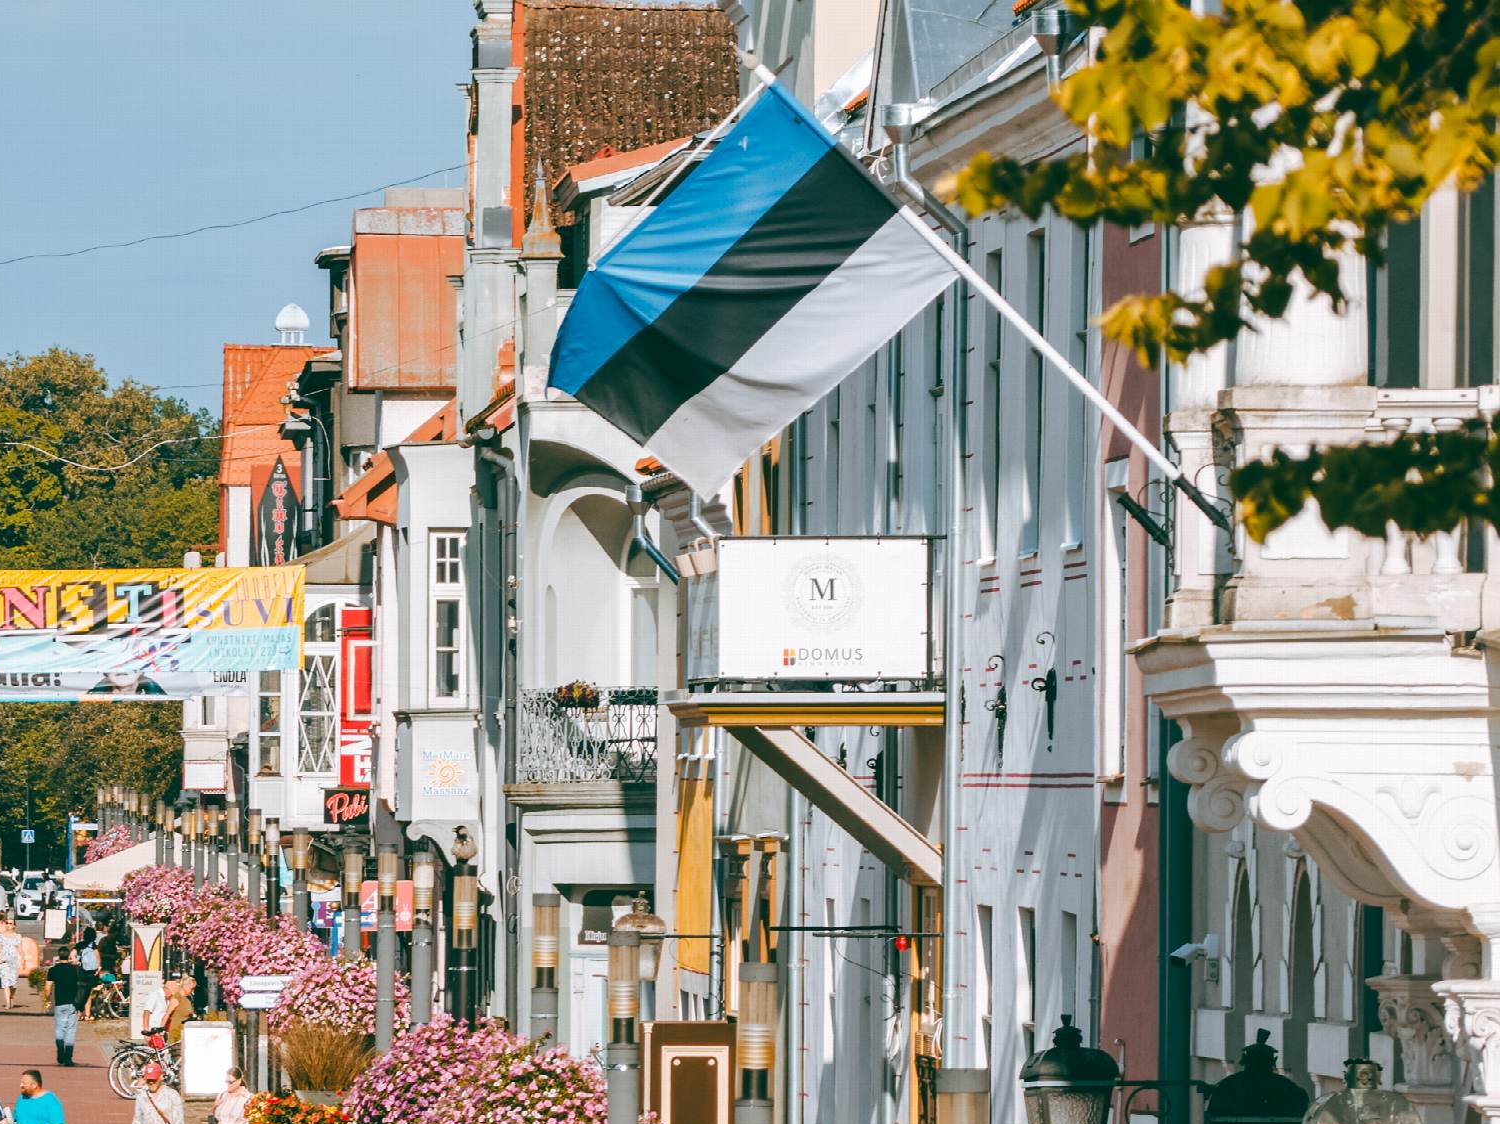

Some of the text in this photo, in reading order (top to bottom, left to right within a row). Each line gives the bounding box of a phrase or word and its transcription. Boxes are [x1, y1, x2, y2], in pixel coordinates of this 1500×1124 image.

[809, 578, 836, 601] M
[195, 597, 293, 627] SUVI
[798, 648, 863, 661] DOMUS
[326, 793, 368, 823] Pubi
